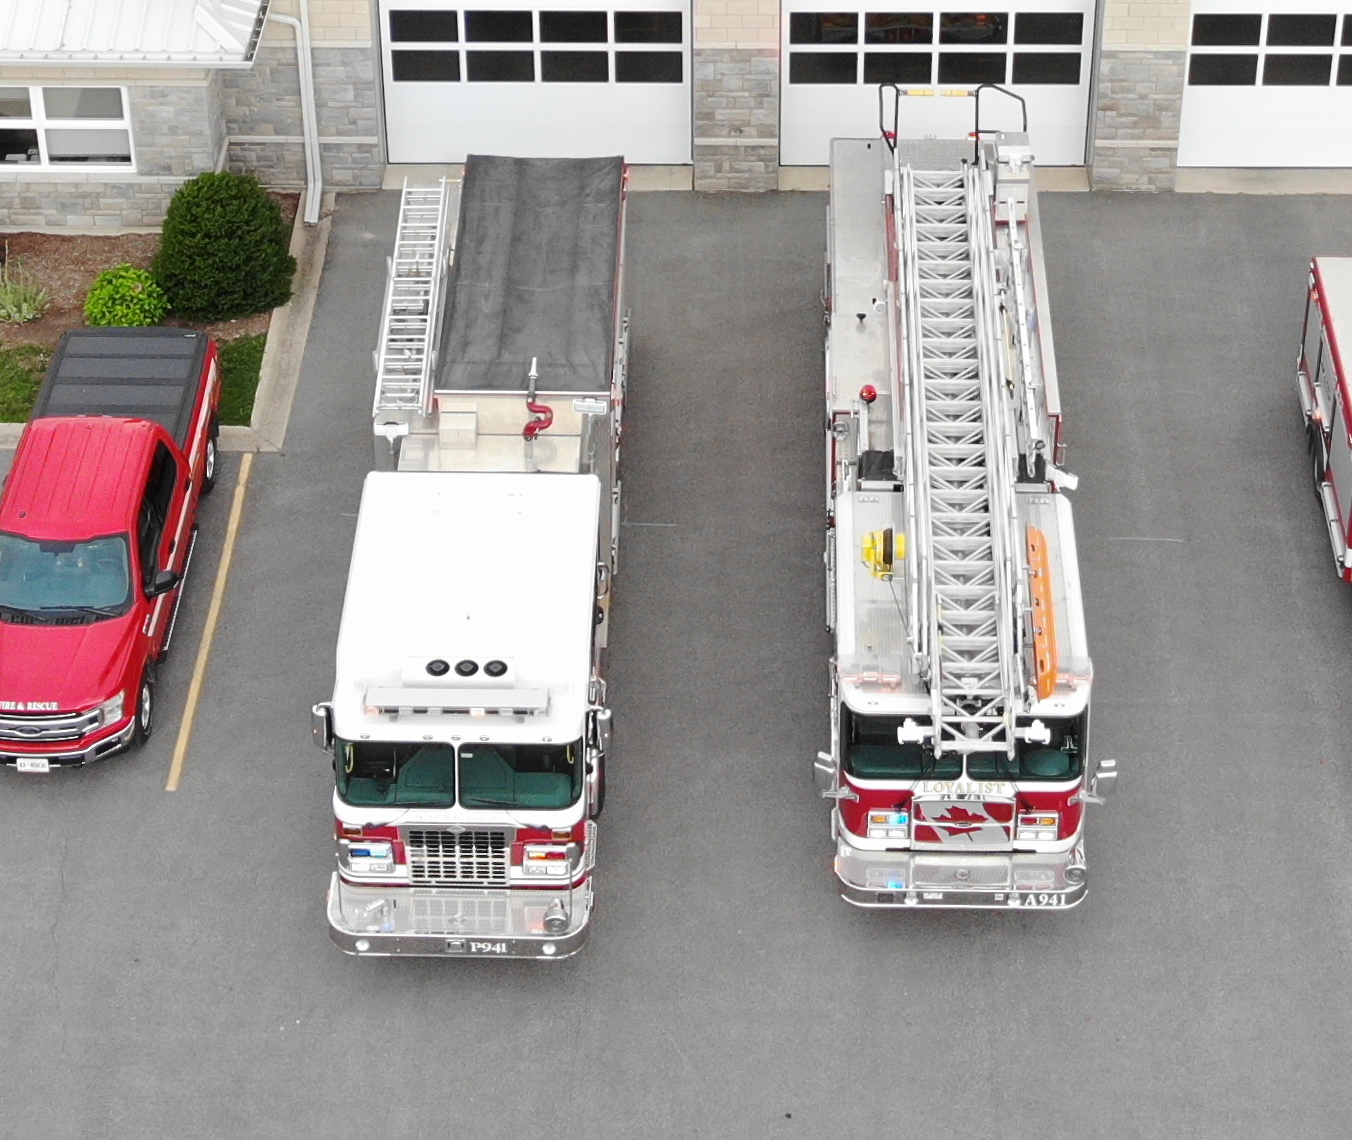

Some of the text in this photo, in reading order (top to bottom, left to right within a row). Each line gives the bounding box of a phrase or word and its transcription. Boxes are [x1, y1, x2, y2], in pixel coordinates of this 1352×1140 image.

[17, 702, 24, 710] &
[27, 702, 58, 710] RESCUE
[922, 781, 1006, 794] LOYALIST
[470, 941, 508, 954] P941
